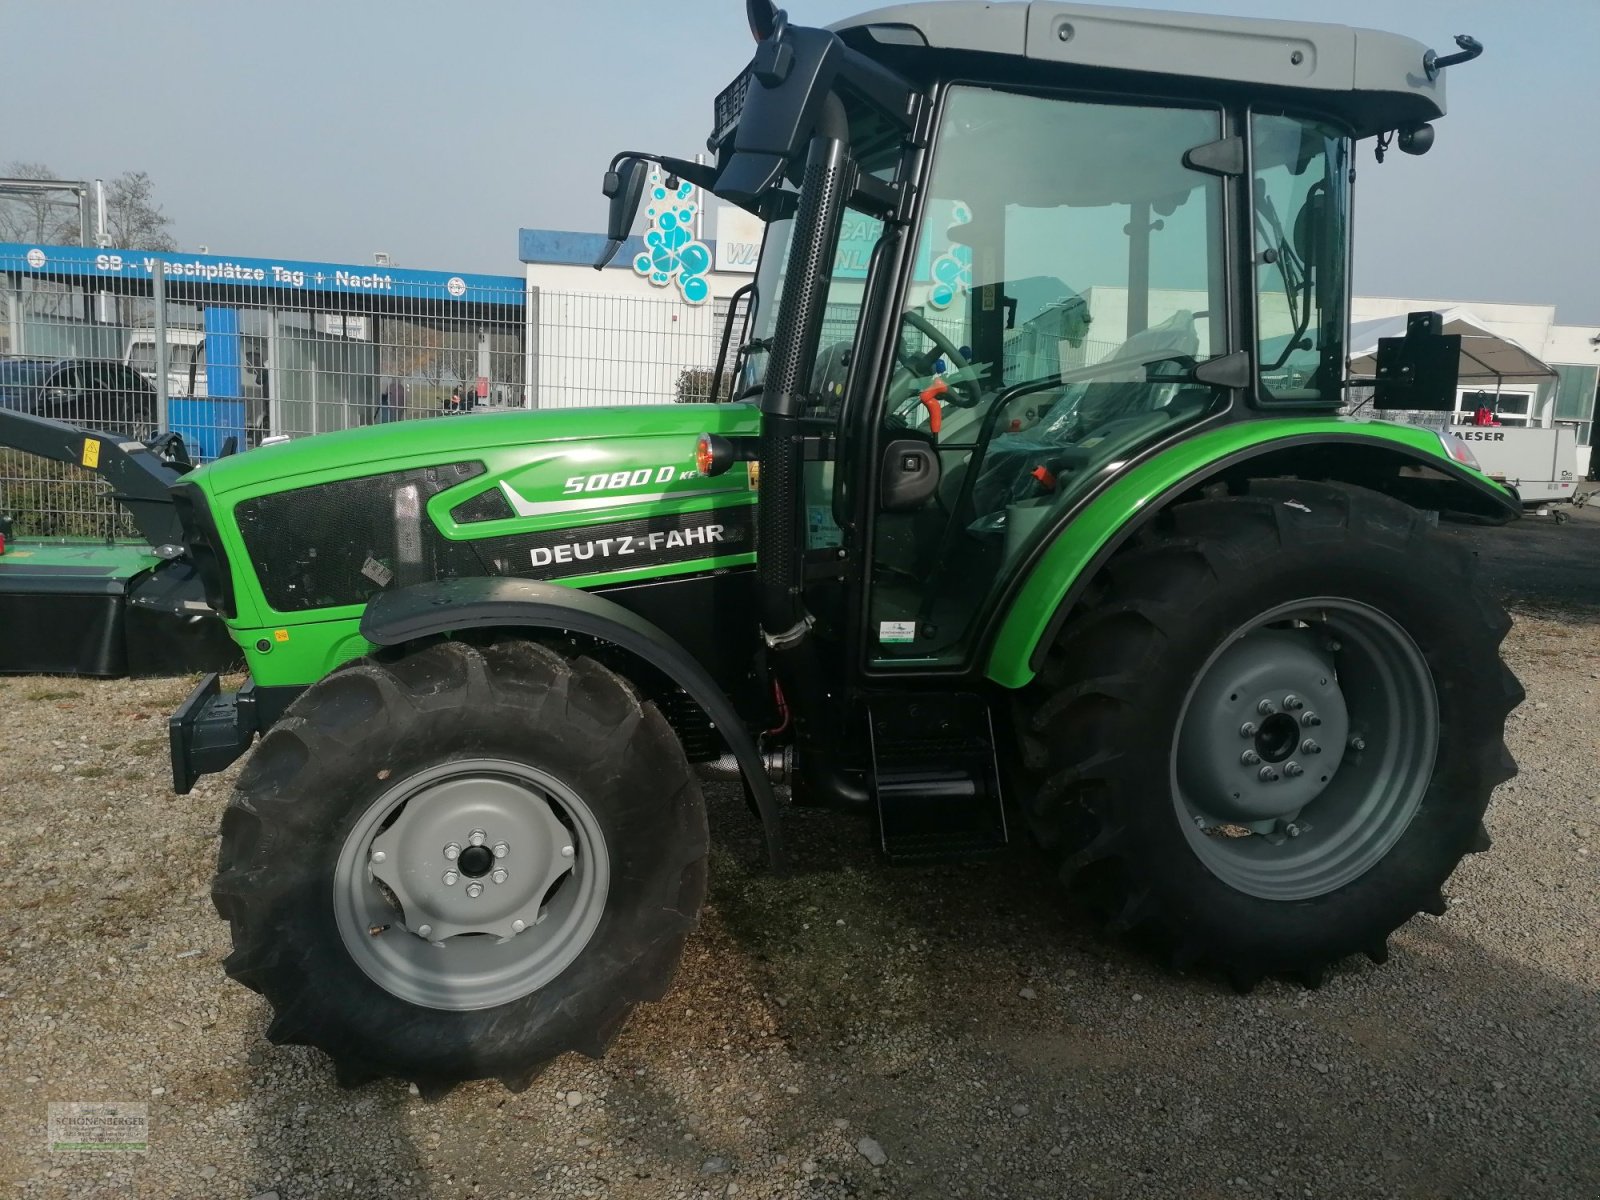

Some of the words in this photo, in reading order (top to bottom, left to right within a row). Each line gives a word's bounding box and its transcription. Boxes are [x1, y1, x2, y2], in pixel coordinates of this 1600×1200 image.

[96, 254, 123, 270] SB
[271, 266, 304, 286] Tag
[314, 271, 326, 285] +
[335, 270, 392, 290] Nacht
[1449, 431, 1505, 442] AESER
[562, 468, 653, 495] 5080
[655, 465, 676, 484] D
[530, 524, 725, 567] DEUTZ-FAHR
